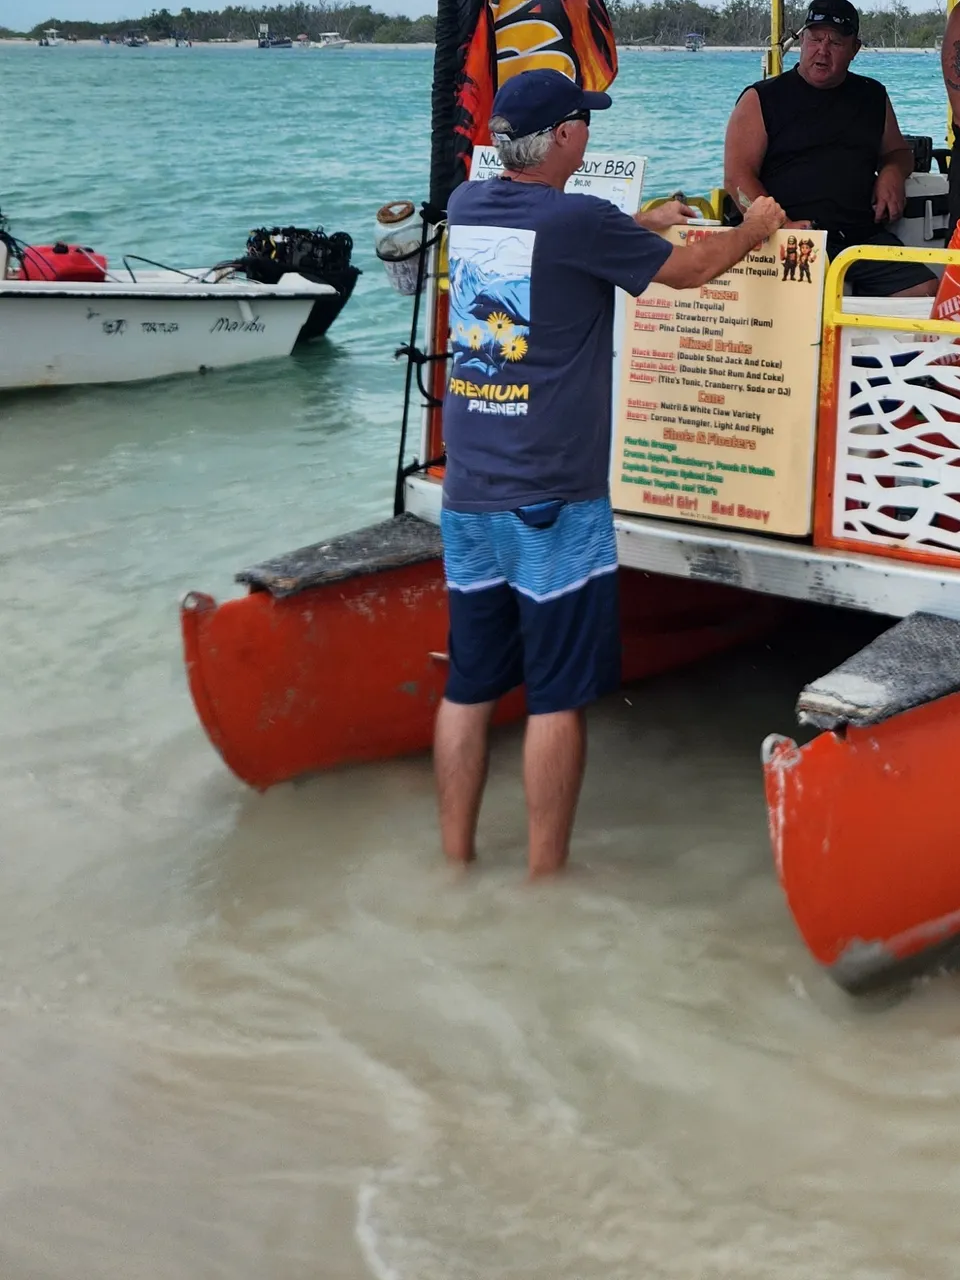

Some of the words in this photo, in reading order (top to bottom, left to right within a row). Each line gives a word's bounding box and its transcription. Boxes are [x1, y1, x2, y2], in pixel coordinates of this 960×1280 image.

[479, 151, 502, 167] NAU
[577, 161, 602, 175] OUY
[604, 160, 636, 177] BBQ
[746, 254, 776, 264] (Vodka)
[745, 268, 779, 278] (Tequila)
[706, 278, 732, 286] unner
[700, 286, 740, 301] Frozen
[674, 299, 692, 309] Lime
[693, 301, 725, 311] (Tequila)
[675, 312, 718, 324] Strawberry
[719, 317, 749, 326] Daiquiri
[750, 319, 774, 328] (Rum)
[659, 324, 675, 332] Pina
[676, 325, 701, 335] Colada
[702, 328, 724, 337] (Rum)
[679, 336, 713, 352] Mixed
[715, 340, 753, 355] Drinks
[677, 352, 705, 362] (Double
[706, 354, 723, 363] Shot
[725, 356, 743, 365] Jack
[744, 357, 760, 366] And
[761, 358, 783, 369] Coke)
[679, 365, 707, 375] (Double
[708, 367, 726, 377] Shot
[727, 369, 745, 378] Rum
[746, 371, 762, 380] And
[763, 372, 785, 383] Coke)
[448, 377, 529, 401] PREMIUM
[658, 376, 681, 385] (Tito's
[704, 380, 745, 392] Cranberry,
[746, 384, 766, 394] Soda
[767, 387, 777, 395] or
[698, 390, 726, 405] Cans
[467, 399, 529, 417] PILSNER
[682, 404, 689, 412] &
[690, 405, 711, 415] White
[713, 407, 731, 417] Claw
[732, 409, 761, 421] Variety
[651, 413, 677, 423] Corona
[714, 421, 734, 431] Light
[735, 424, 750, 432] And
[751, 425, 775, 436] Flight
[663, 427, 695, 444] Shots
[696, 431, 706, 444] &
[707, 432, 757, 450] Floaters
[643, 491, 674, 505] Nauti
[676, 495, 699, 511] Girl
[711, 500, 735, 516] Bad
[738, 504, 771, 524] Bouy
